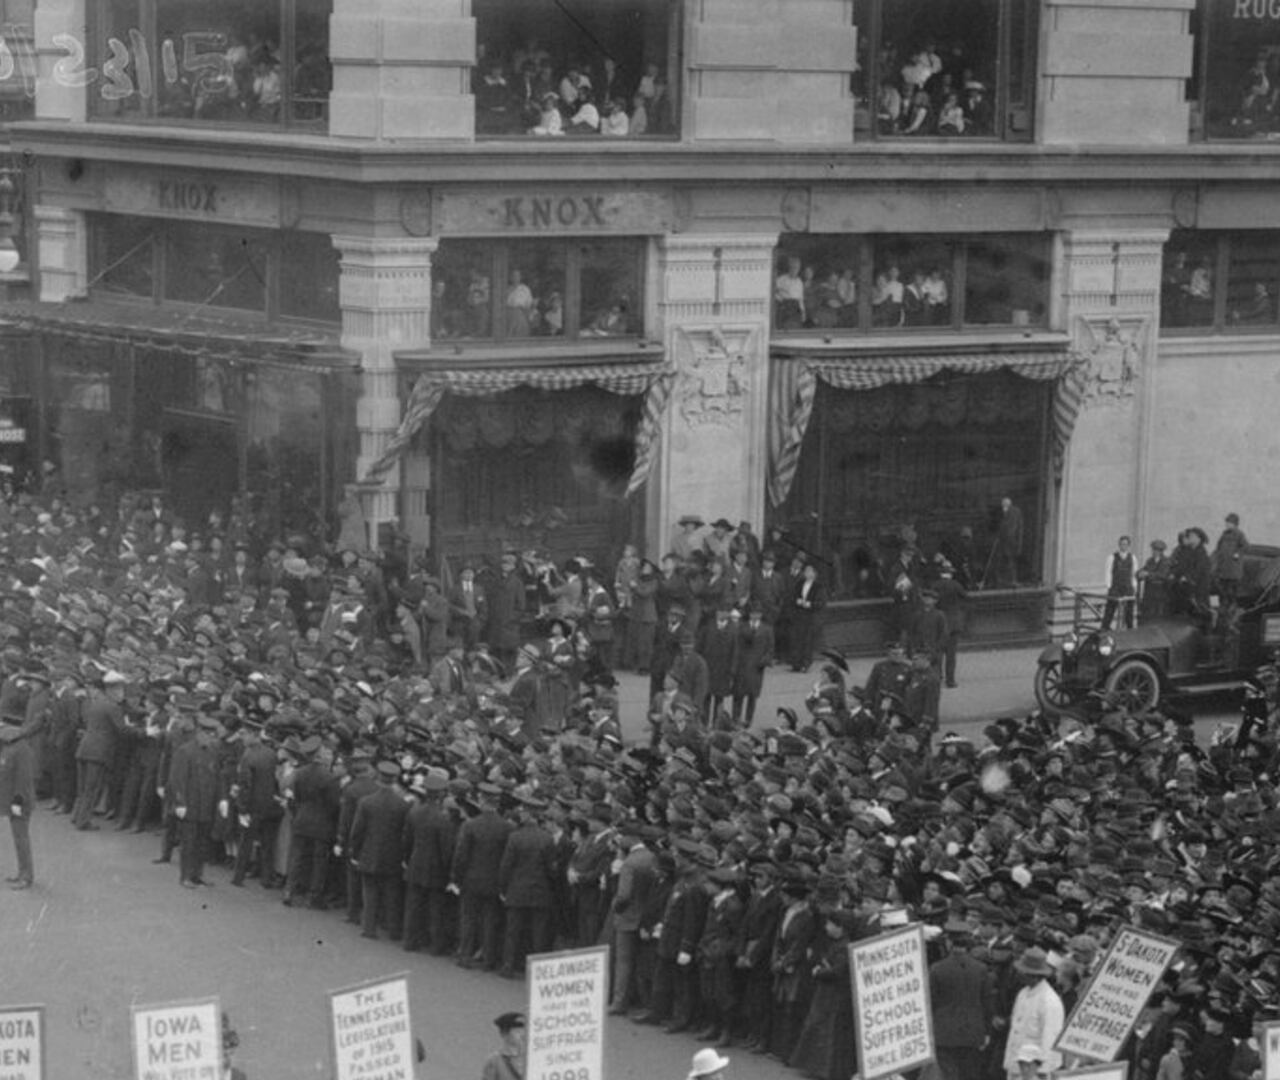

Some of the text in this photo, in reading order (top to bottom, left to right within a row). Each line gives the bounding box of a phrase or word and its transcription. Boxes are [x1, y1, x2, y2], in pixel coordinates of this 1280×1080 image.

[159, 181, 217, 212] KNOX
[504, 196, 606, 227] KNOX
[535, 960, 598, 979] DELAWARE
[861, 961, 914, 988] WOMEN
[1105, 959, 1153, 985] WOMEN
[356, 991, 384, 1006] THE
[539, 981, 595, 998] WOMEN
[862, 979, 920, 1008] HAVE HAD
[864, 1001, 922, 1028] SCHOOL
[1083, 991, 1133, 1018] SCHOOL
[147, 1015, 201, 1039] IOWA
[533, 1012, 596, 1032] SCHOOL
[864, 1018, 926, 1050] SUFFRAGE
[148, 1041, 202, 1064] MEN
